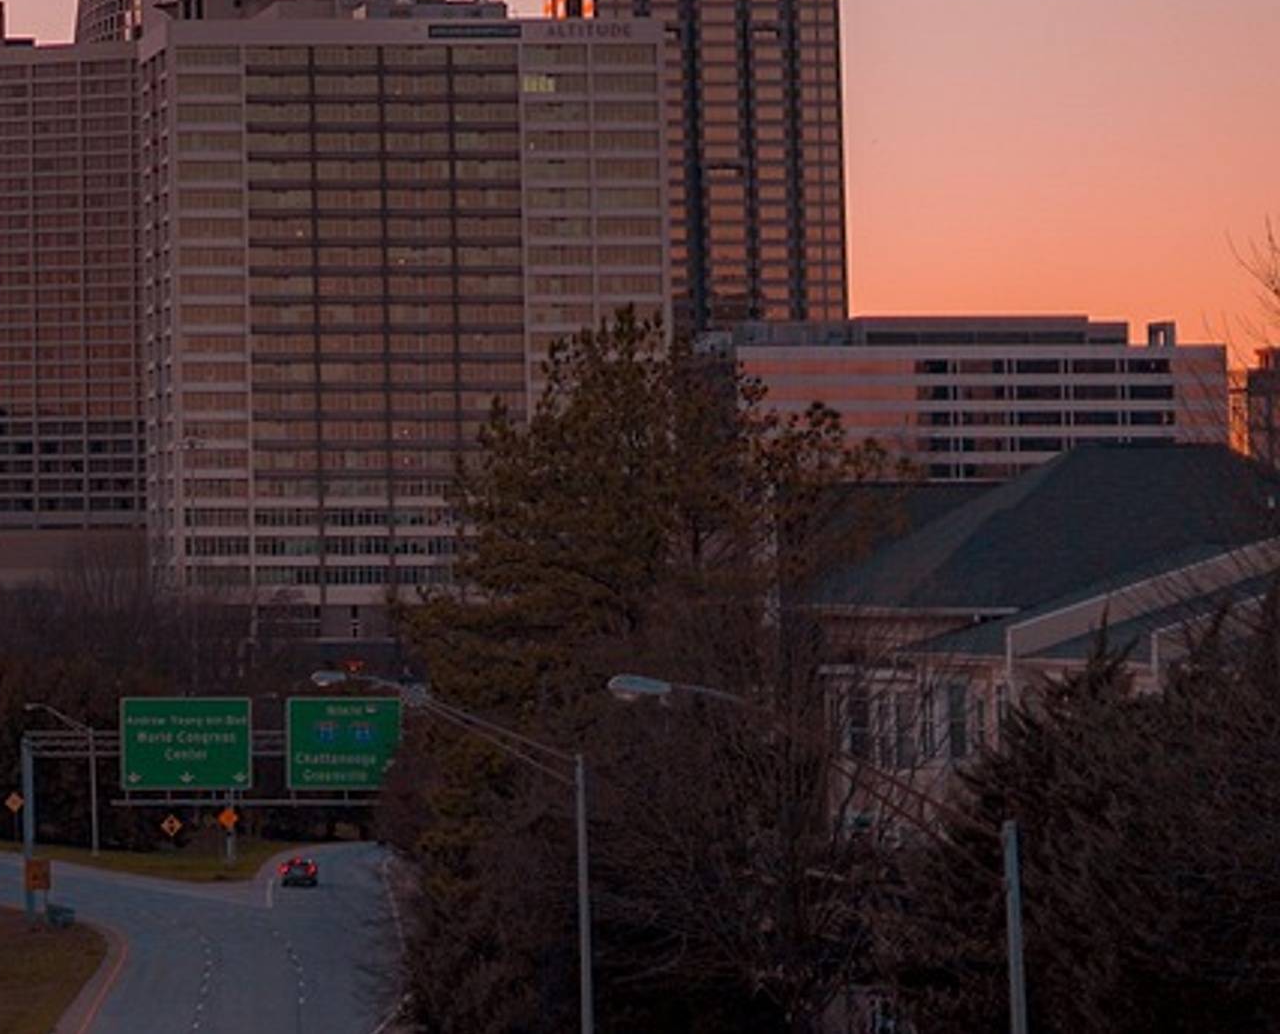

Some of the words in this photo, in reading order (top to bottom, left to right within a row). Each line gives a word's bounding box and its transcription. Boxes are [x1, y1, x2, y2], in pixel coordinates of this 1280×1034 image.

[547, 22, 632, 38] ALTITUDE
[135, 731, 174, 744] World
[175, 730, 237, 745] Congress
[163, 748, 208, 761] Center
